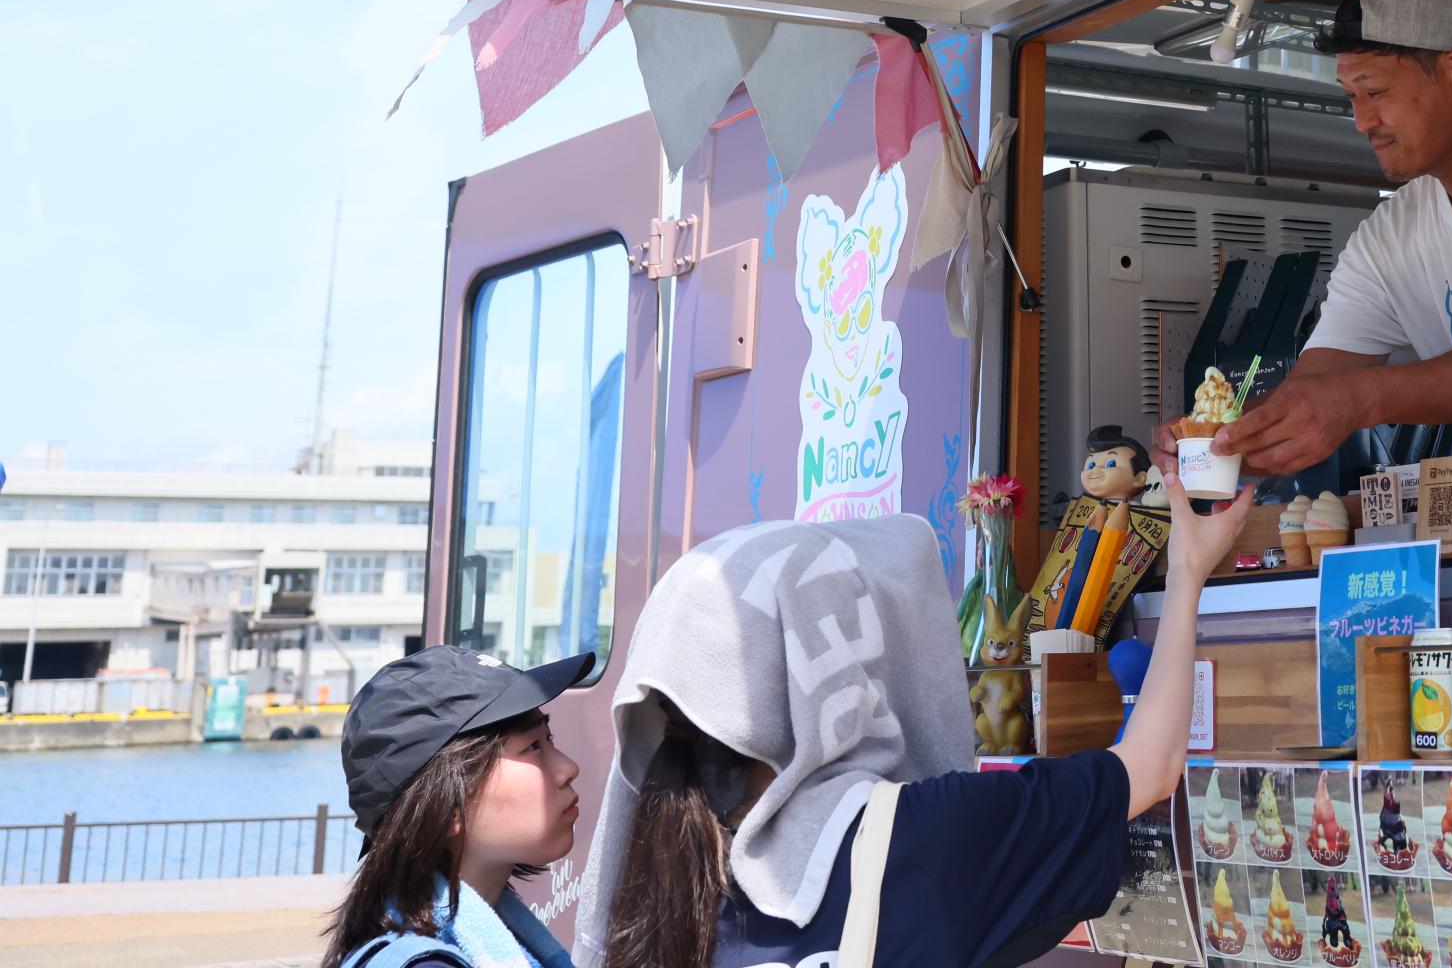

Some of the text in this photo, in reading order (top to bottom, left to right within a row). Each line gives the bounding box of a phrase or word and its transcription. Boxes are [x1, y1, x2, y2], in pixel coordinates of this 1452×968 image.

[1329, 615, 1426, 638] フルーツビネガー
[1416, 734, 1437, 747] 600
[1261, 848, 1286, 859] スパイス
[1311, 849, 1349, 861] ストロベリー
[1376, 853, 1417, 866] チョコレート
[1217, 939, 1241, 951] マンゴー
[1272, 946, 1299, 959] オレンジ
